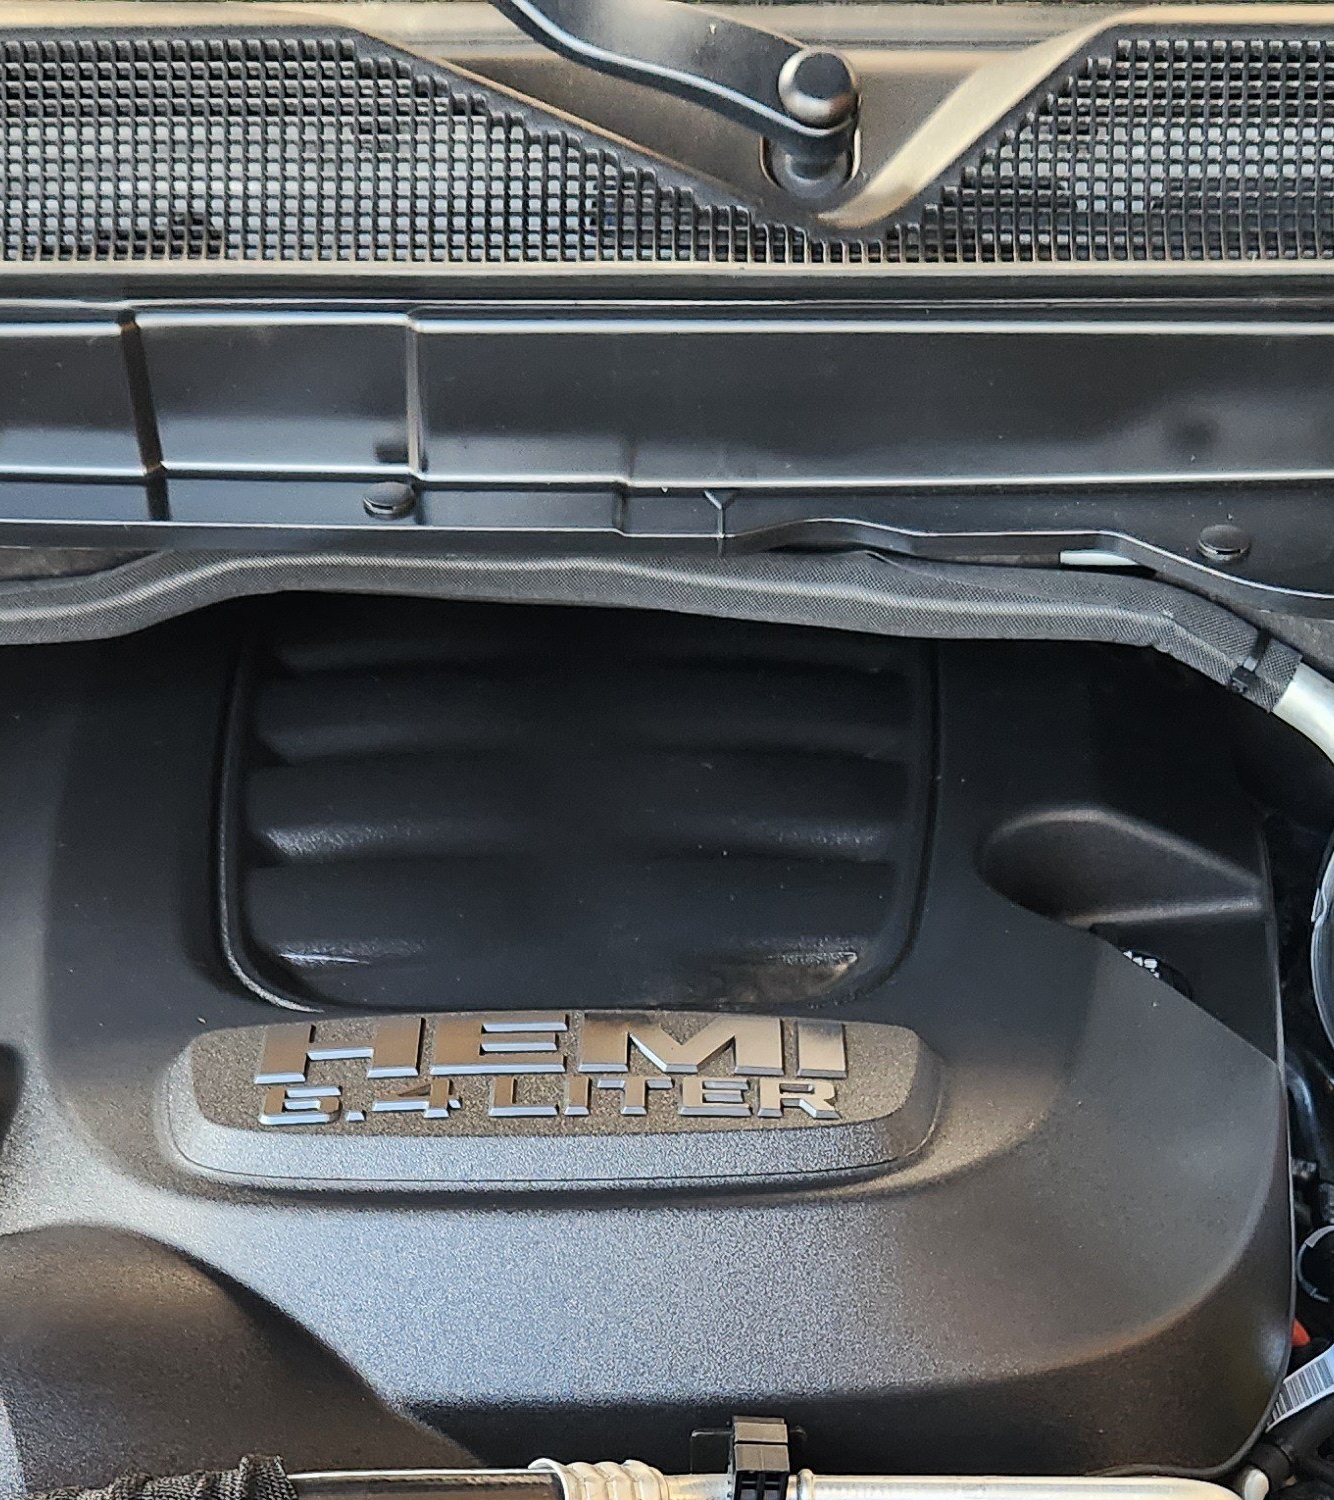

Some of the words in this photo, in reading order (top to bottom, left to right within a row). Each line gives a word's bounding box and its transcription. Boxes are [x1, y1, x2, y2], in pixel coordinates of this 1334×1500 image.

[253, 1009, 848, 1085] HEMI
[257, 1077, 462, 1124] 6.4
[487, 1076, 842, 1119] LITER
